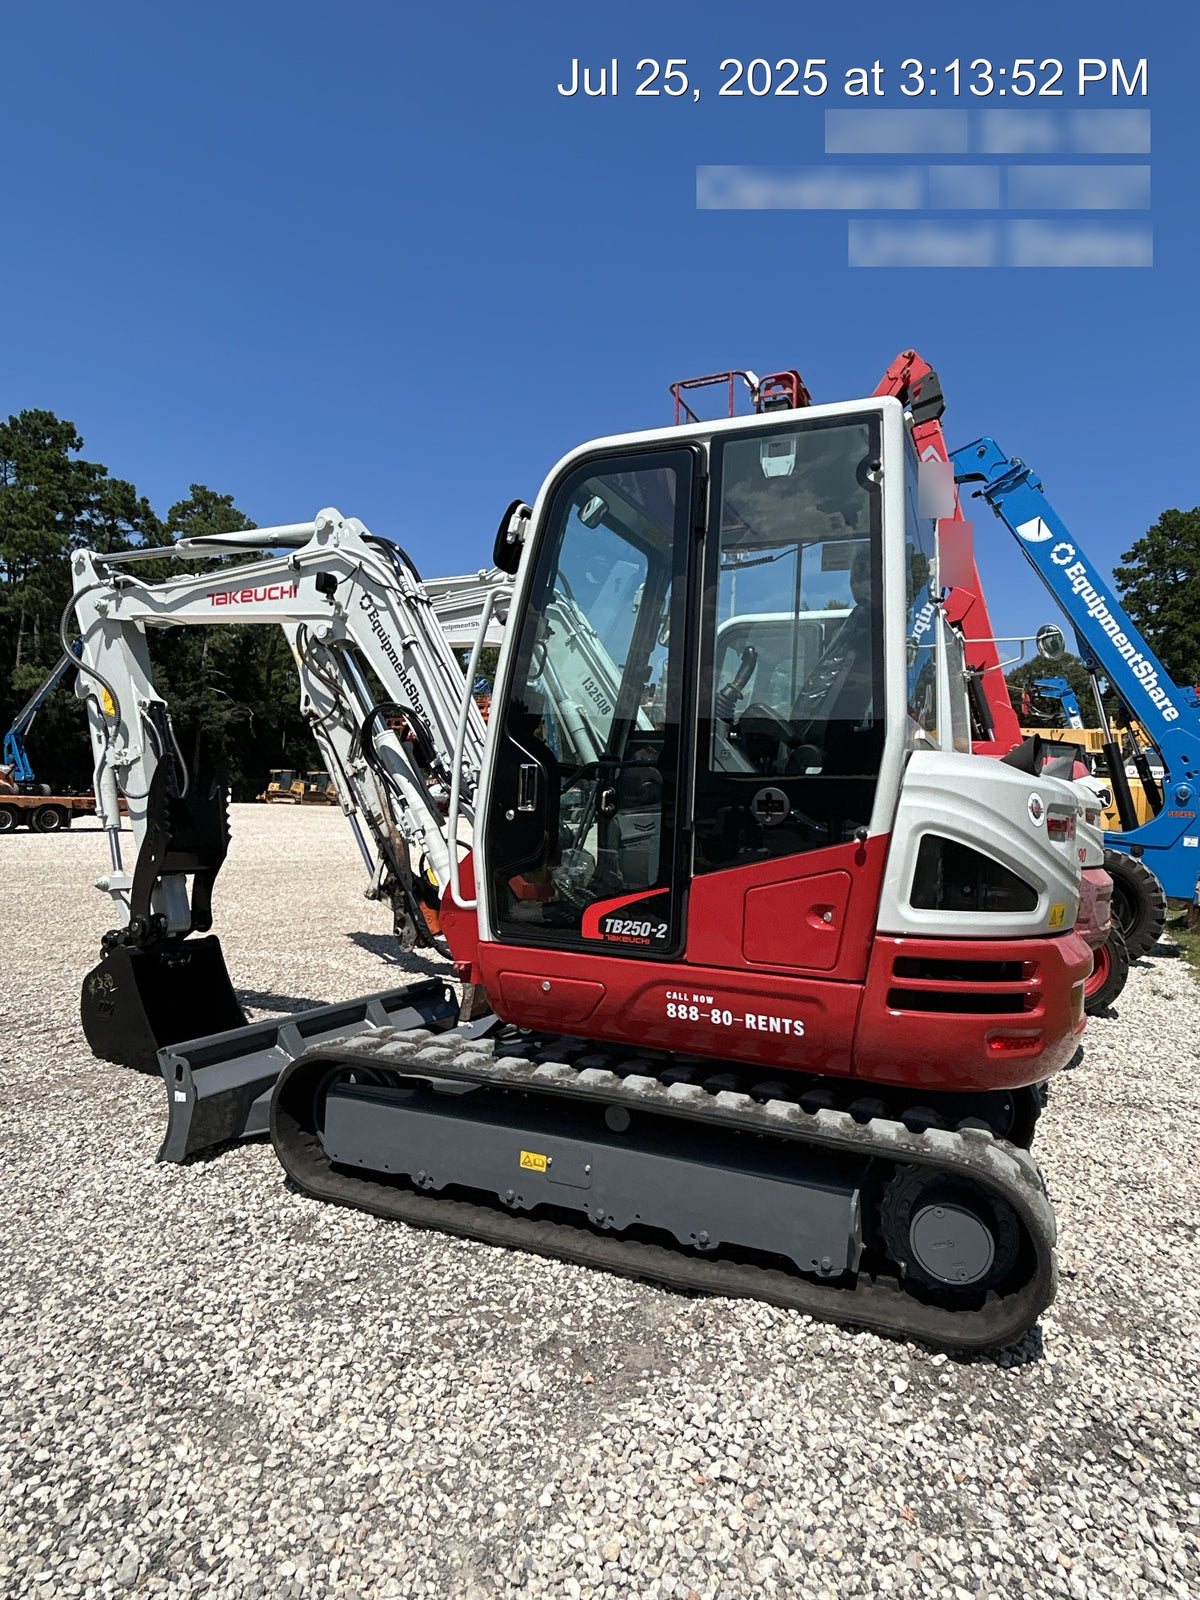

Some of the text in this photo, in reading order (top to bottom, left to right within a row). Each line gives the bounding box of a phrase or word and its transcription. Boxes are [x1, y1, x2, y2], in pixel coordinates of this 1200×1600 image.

[1064, 560, 1180, 722] EquipmentShare
[581, 676, 612, 716] 132508
[605, 918, 668, 939] TB250-2
[665, 991, 714, 1005] CALL NOW
[666, 1002, 806, 1037] 888-80-RENTS
